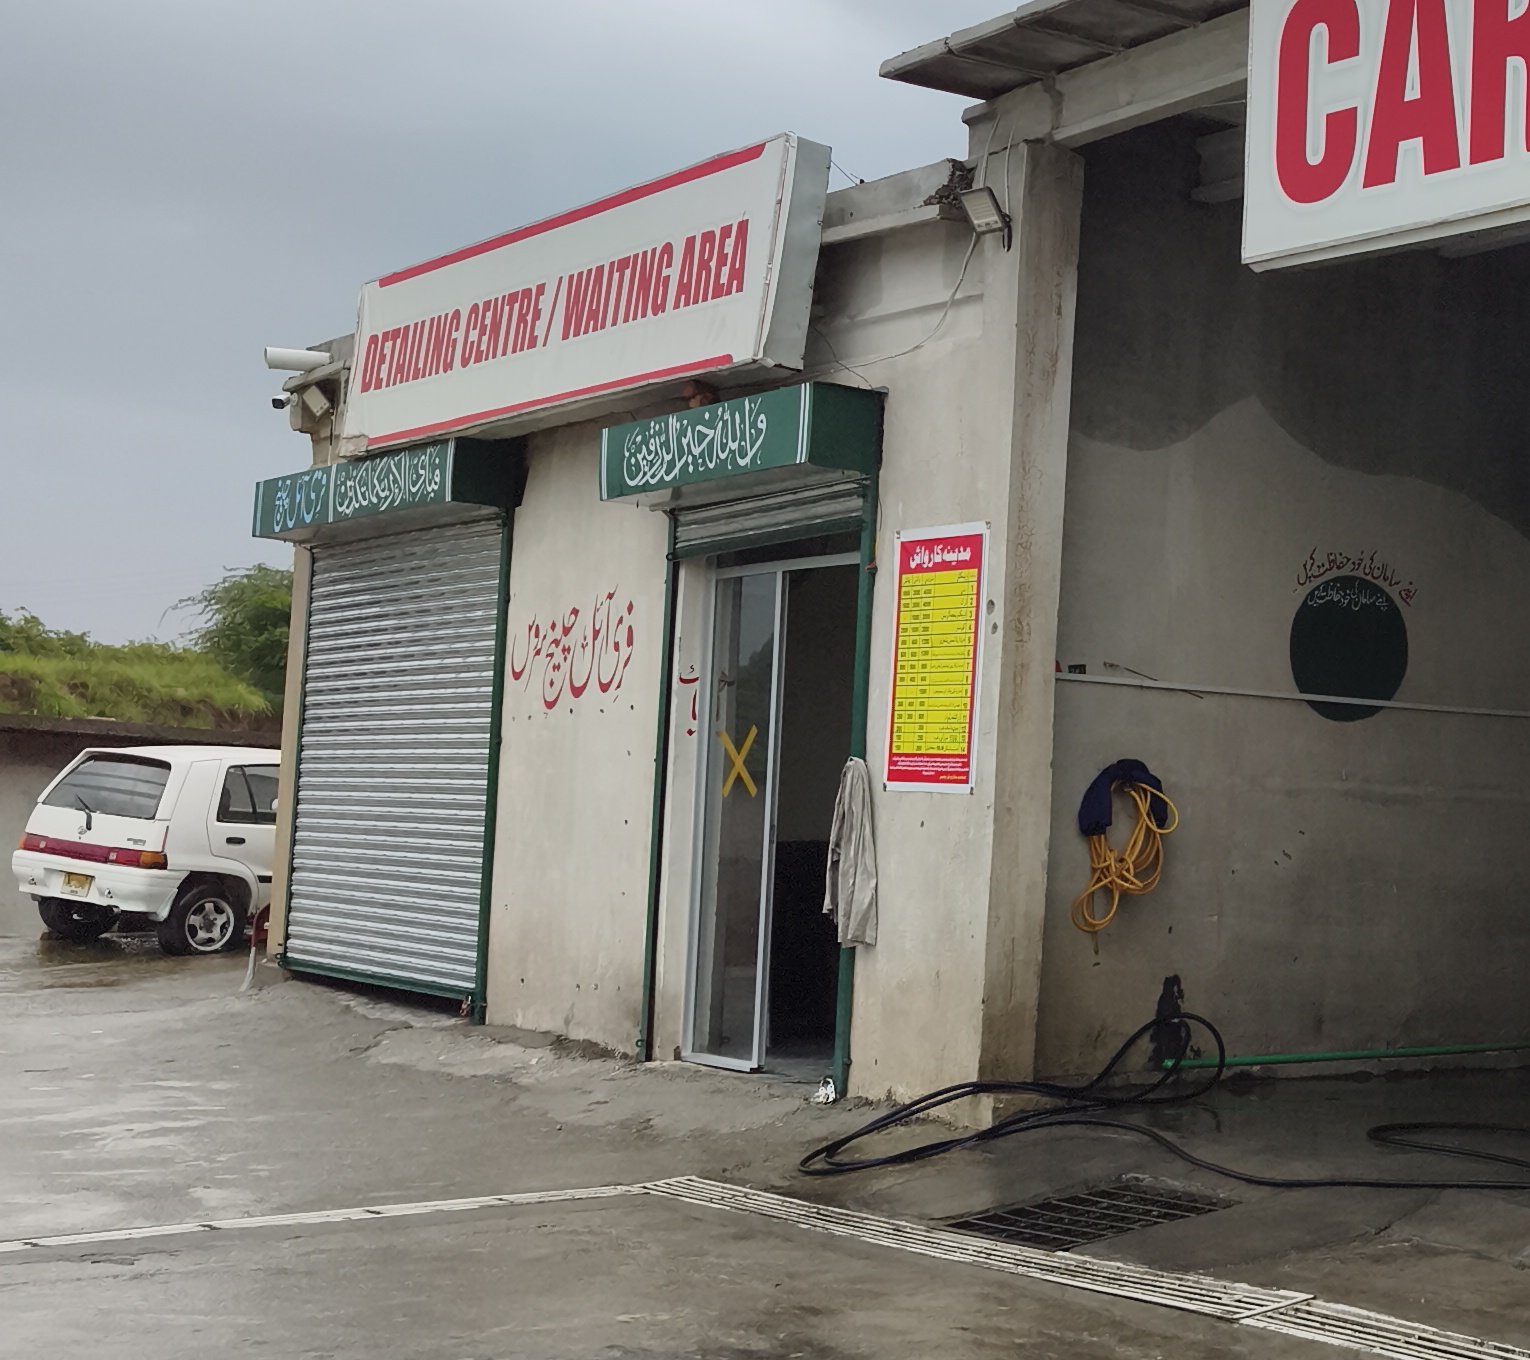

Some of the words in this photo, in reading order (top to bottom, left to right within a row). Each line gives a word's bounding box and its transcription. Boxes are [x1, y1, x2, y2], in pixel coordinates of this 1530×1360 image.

[361, 308, 461, 393] DETAILING
[461, 282, 546, 369] CENTRE
[543, 276, 563, 347] /
[561, 241, 674, 341] WAITING
[673, 218, 750, 311] AREA
[511, 613, 548, 693] سروس
[597, 600, 634, 703] فری
